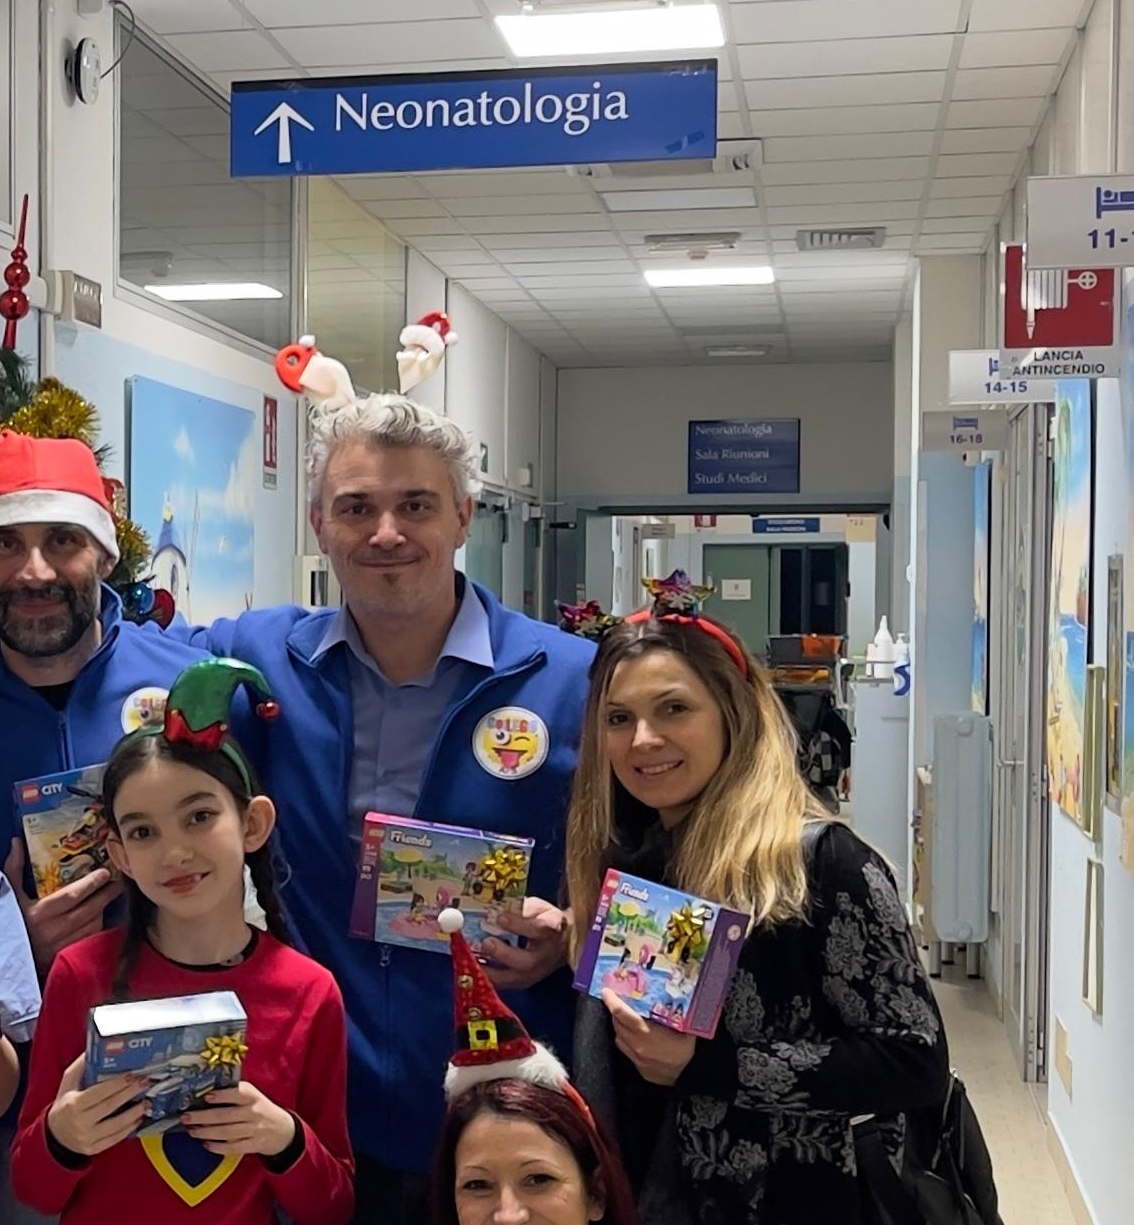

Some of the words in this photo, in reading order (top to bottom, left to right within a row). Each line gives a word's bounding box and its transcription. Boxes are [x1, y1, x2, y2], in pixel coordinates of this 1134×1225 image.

[334, 81, 629, 135] Neonatologia
[1087, 228, 1134, 249] 11-
[1033, 350, 1084, 362] LANCIA
[1012, 363, 1106, 376] ANTINCENDIO
[984, 381, 1028, 394] 14-15
[695, 424, 773, 438] Neonatologia
[949, 433, 983, 444] 16-18
[695, 448, 719, 460] Sala
[721, 448, 770, 460] Riunioni
[694, 472, 724, 485] Studi
[726, 472, 768, 484] Medici
[41, 782, 63, 795] CITY
[389, 830, 433, 848] Friends
[620, 882, 650, 902] Friends
[128, 1037, 154, 1049] CITY
